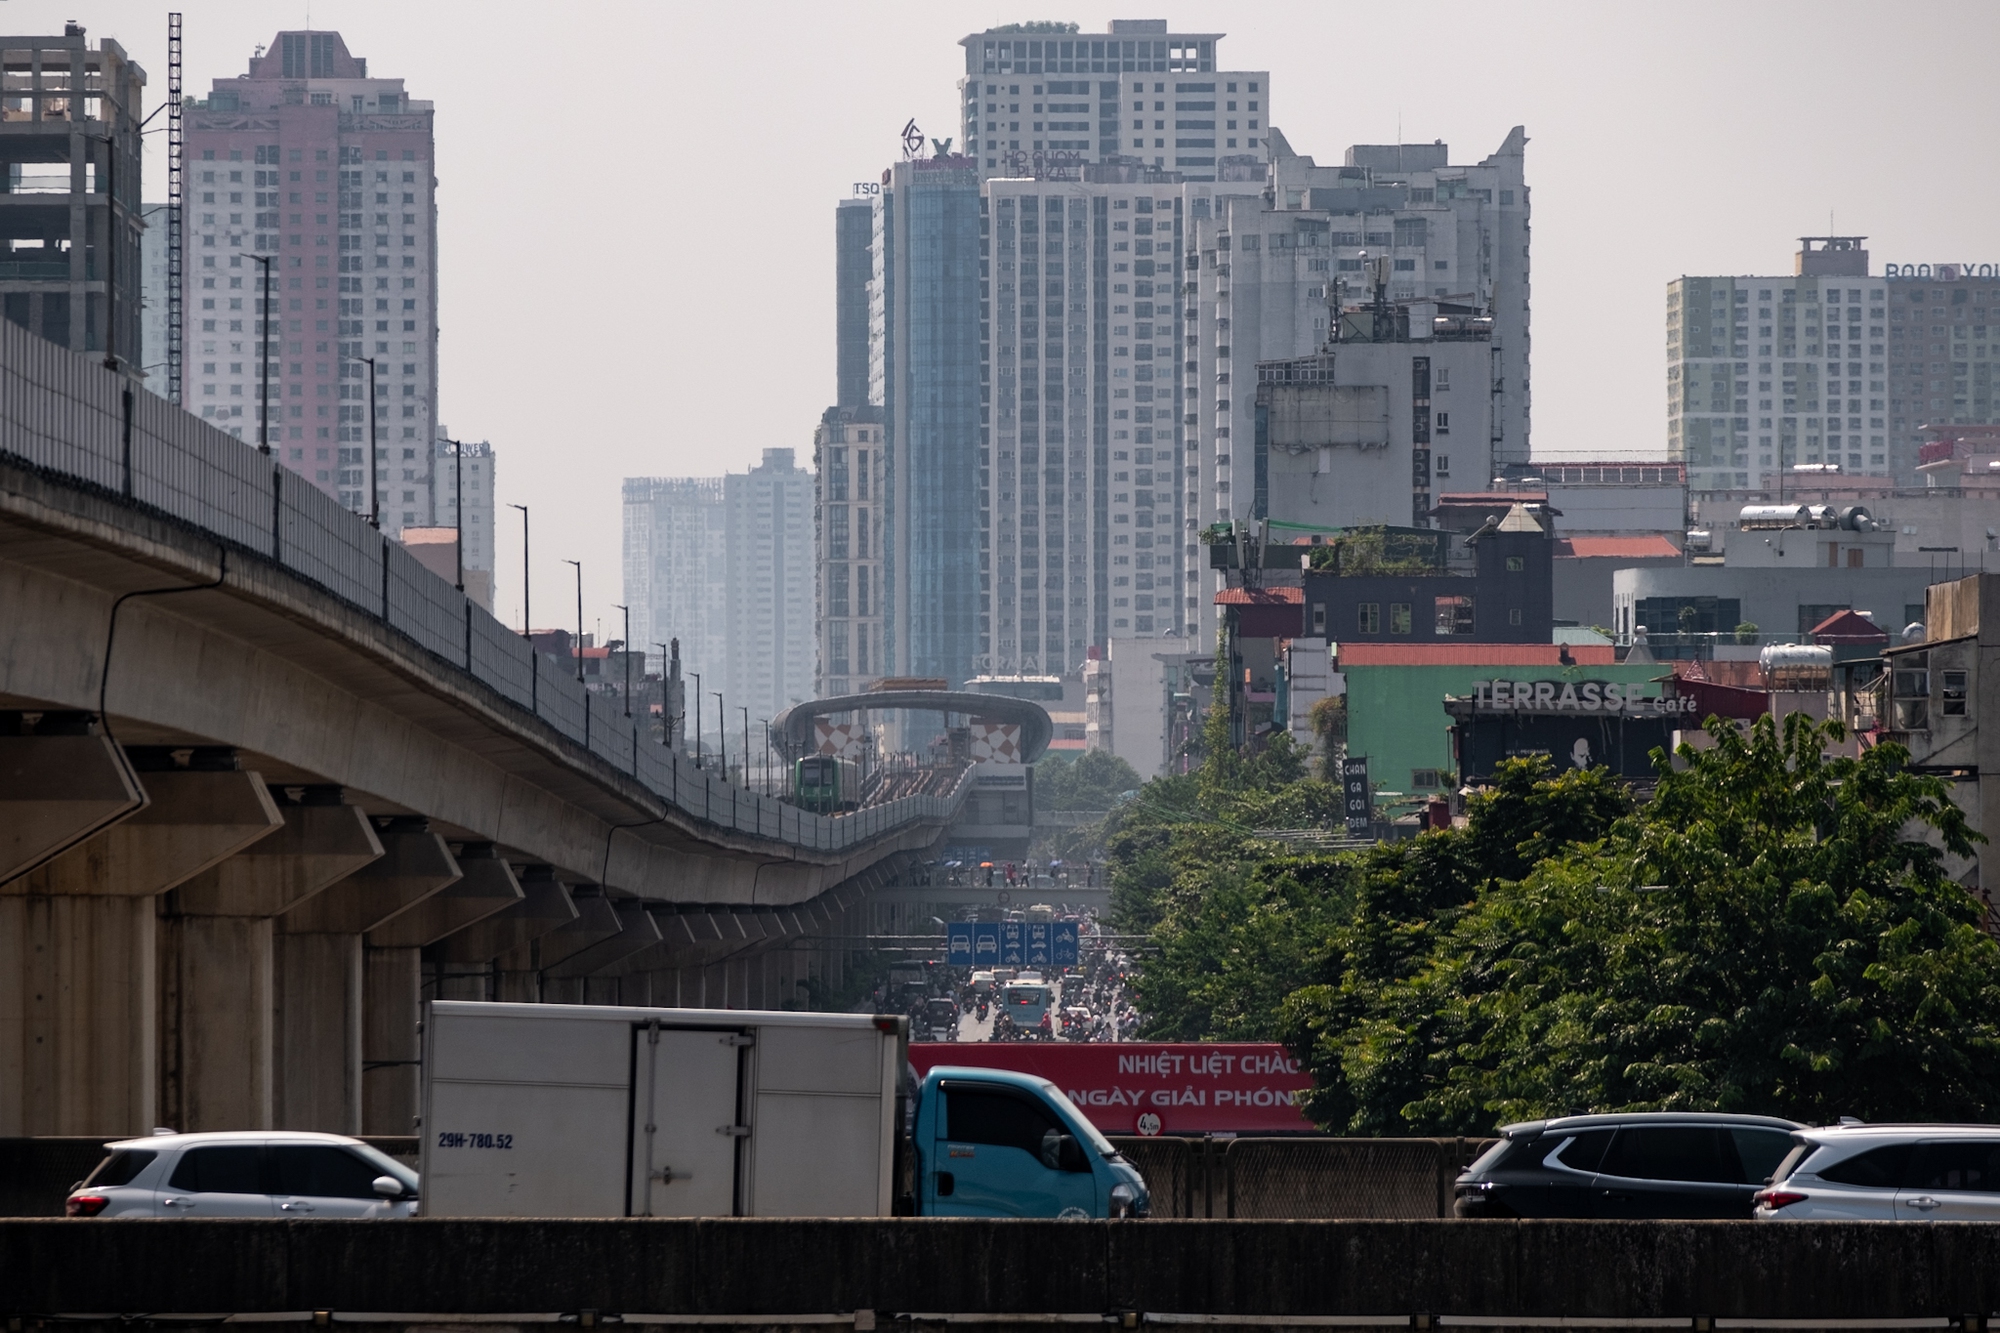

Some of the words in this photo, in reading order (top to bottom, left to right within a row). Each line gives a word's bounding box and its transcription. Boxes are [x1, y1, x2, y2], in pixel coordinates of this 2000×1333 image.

[1004, 150, 1028, 163] HO
[1017, 165, 1067, 178] PLAZA
[853, 182, 880, 195] TSQ
[1472, 680, 1645, 711] TERRASSE
[1350, 781, 1362, 793] GA
[1118, 1050, 1184, 1079] NHIỆT
[1189, 1050, 1236, 1079] LIỆT
[1069, 1085, 1145, 1106] NGÀY
[1151, 1085, 1206, 1106] GIẢI
[1215, 1086, 1304, 1107] PHÓN
[1139, 1115, 1160, 1131] 4,5m
[438, 1131, 514, 1149] 29H-780.52
